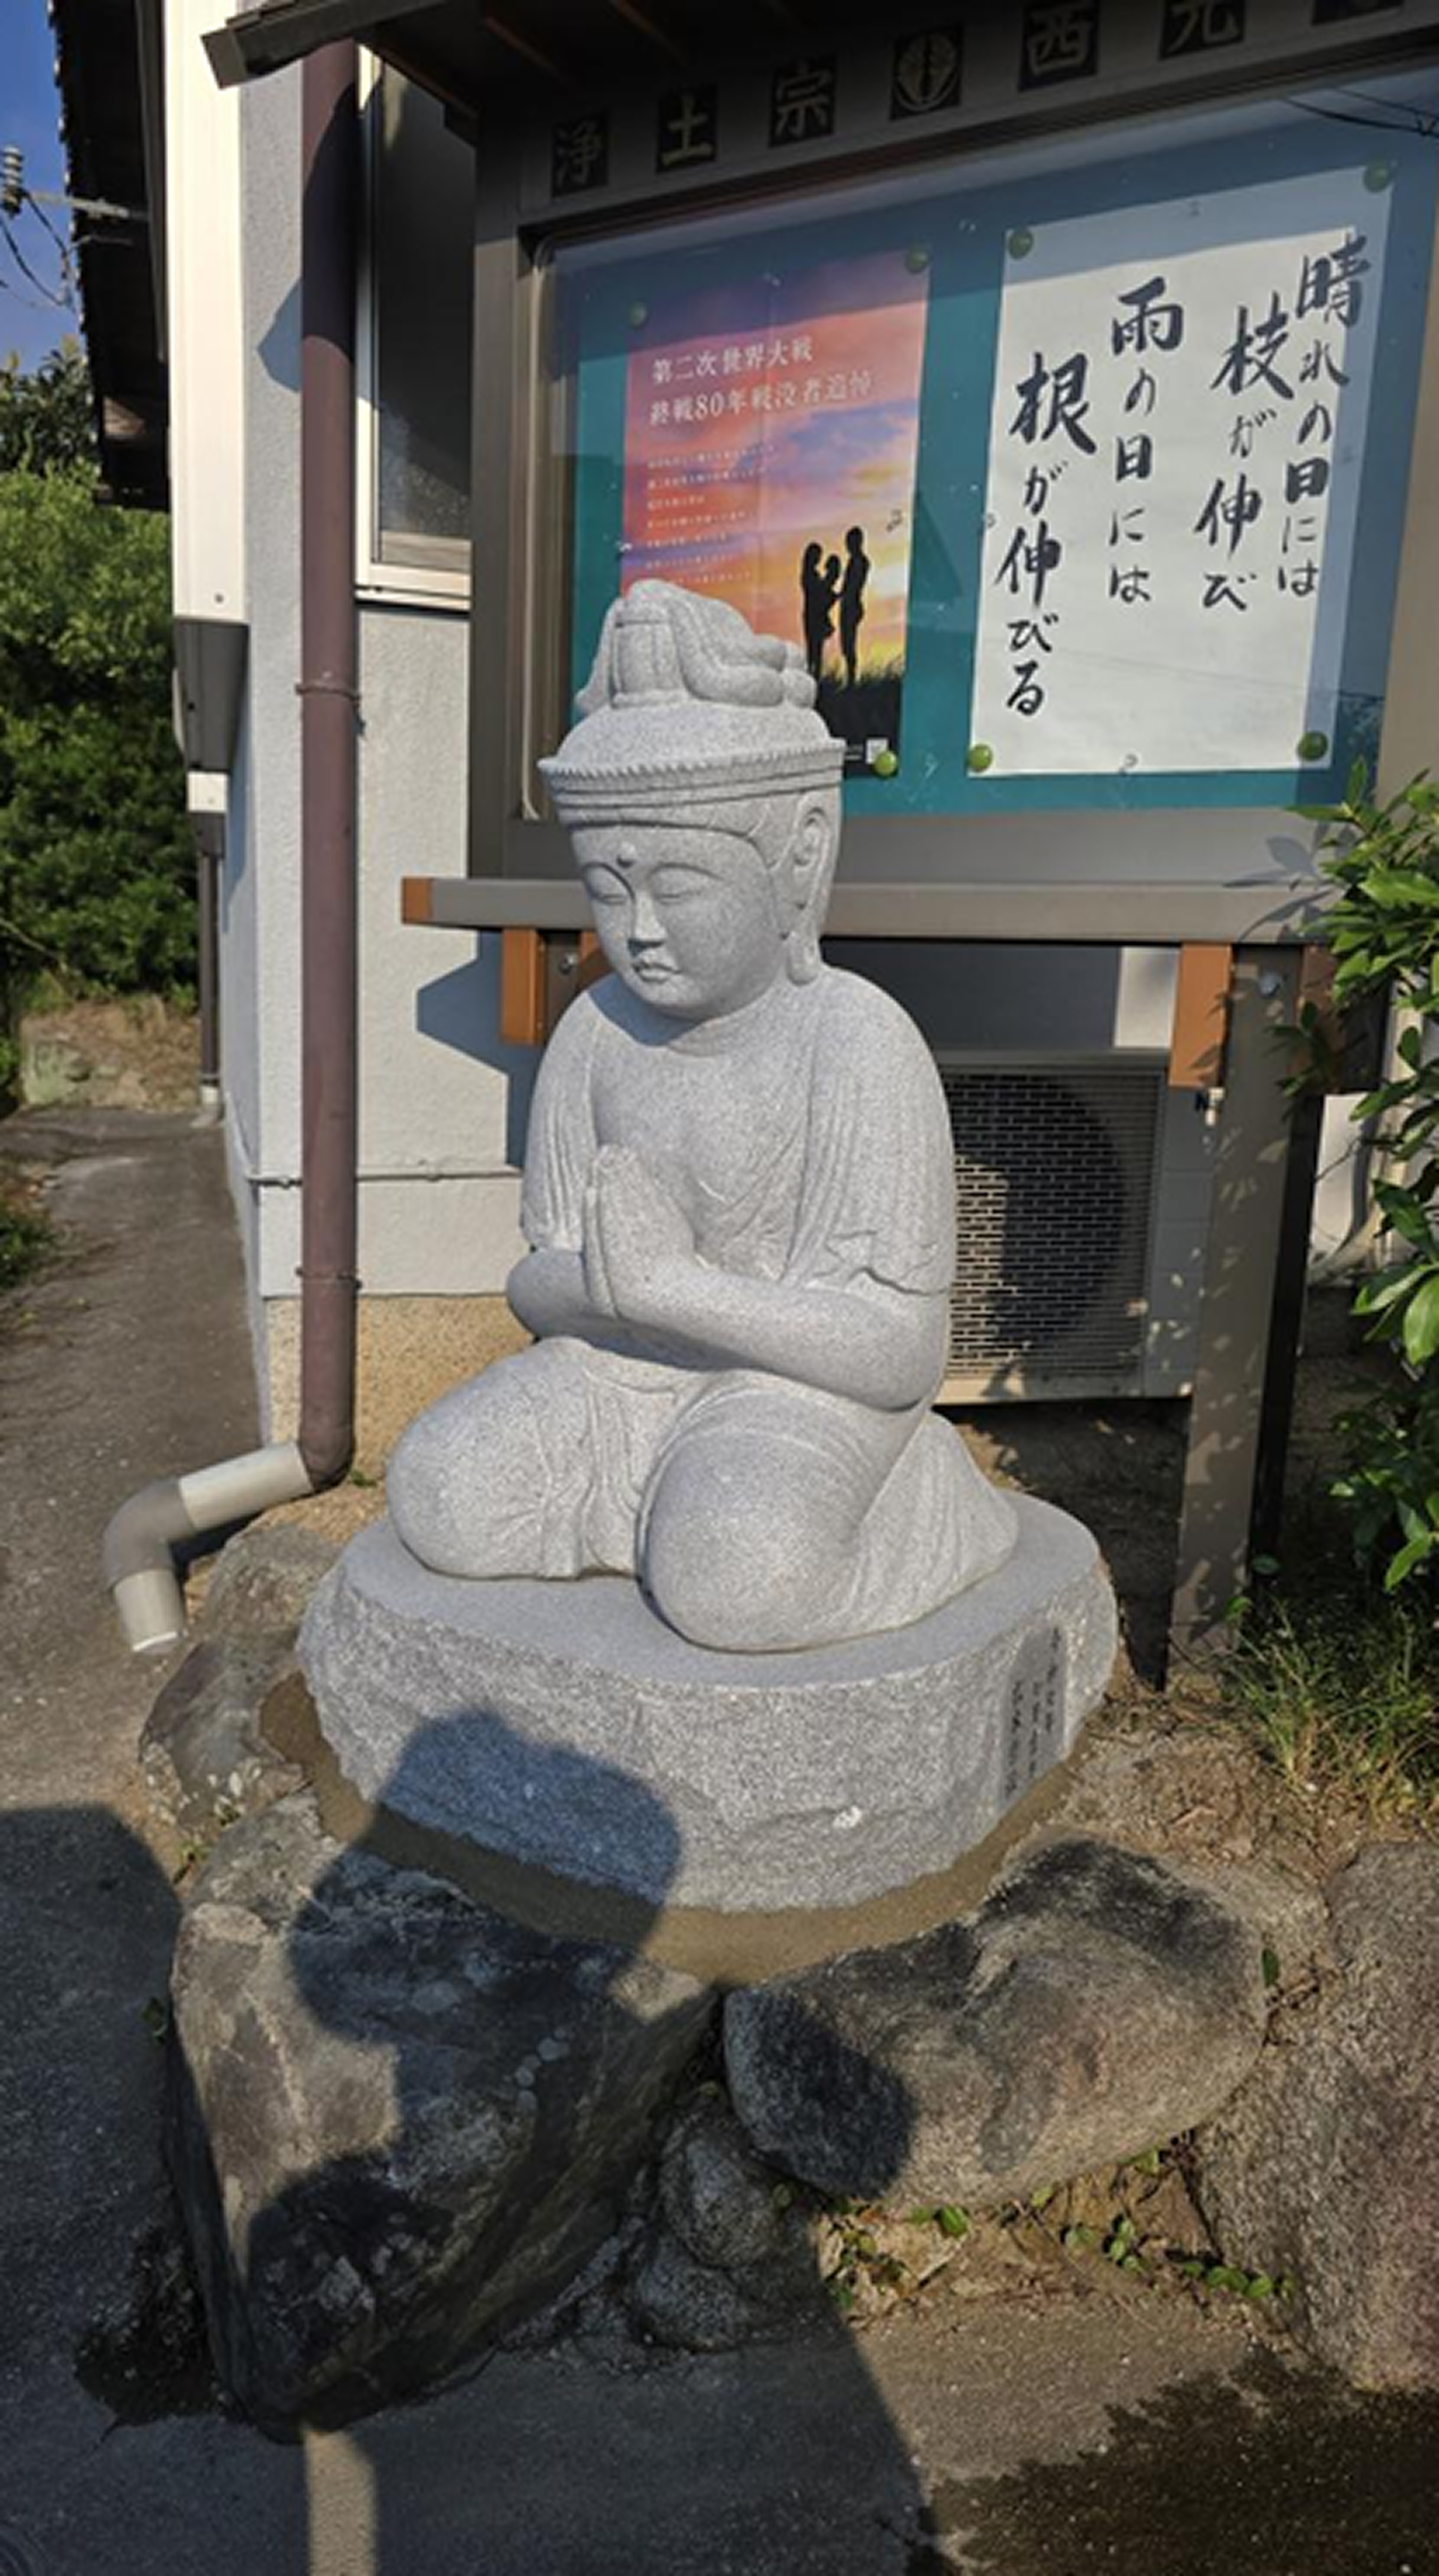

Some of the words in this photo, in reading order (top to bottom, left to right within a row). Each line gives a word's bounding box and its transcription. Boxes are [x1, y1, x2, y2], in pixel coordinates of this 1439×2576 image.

[652, 337, 814, 385] 第二次世界大戦
[1108, 277, 1184, 605] 雨の日には
[1194, 291, 1295, 610] 枝が伸び
[1278, 233, 1371, 597] 晴れの日には
[993, 351, 1096, 716] 根が伸びる
